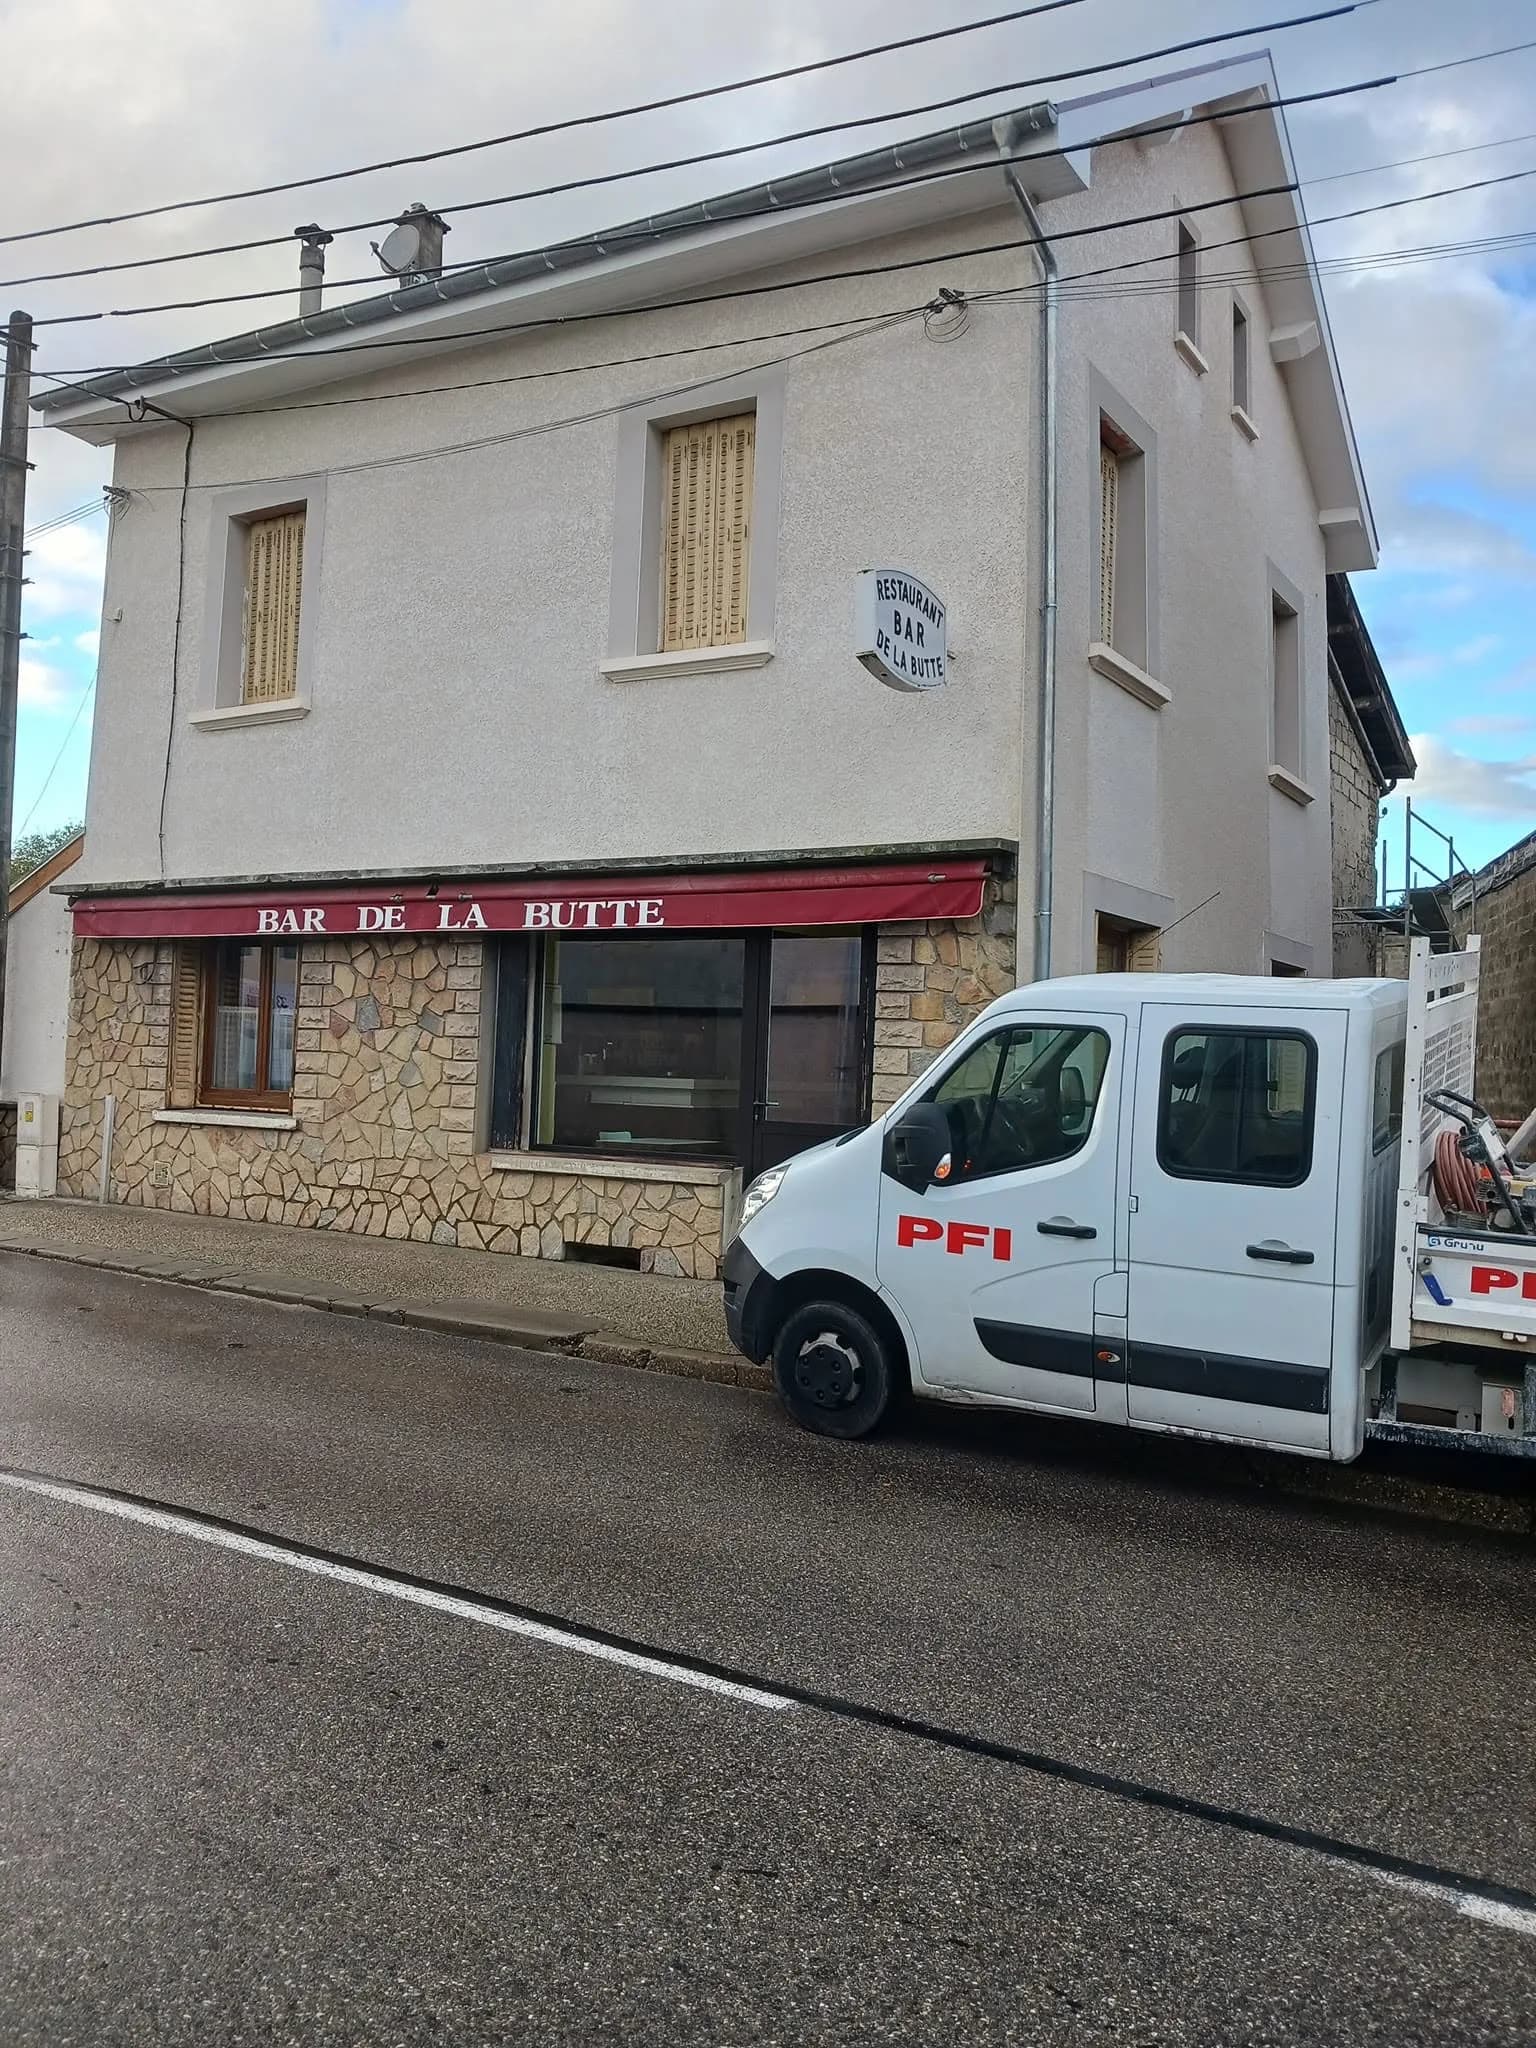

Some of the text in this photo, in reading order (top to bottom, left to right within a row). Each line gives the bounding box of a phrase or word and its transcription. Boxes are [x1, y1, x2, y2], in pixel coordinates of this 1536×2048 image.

[876, 578, 944, 629] RESTAURANT
[894, 609, 925, 648] BAR
[876, 628, 944, 678] DE LA BUTTE
[256, 899, 665, 933] BAR DE LA BUTTE
[897, 1214, 1012, 1262] PFI
[1470, 1266, 1536, 1300] P
